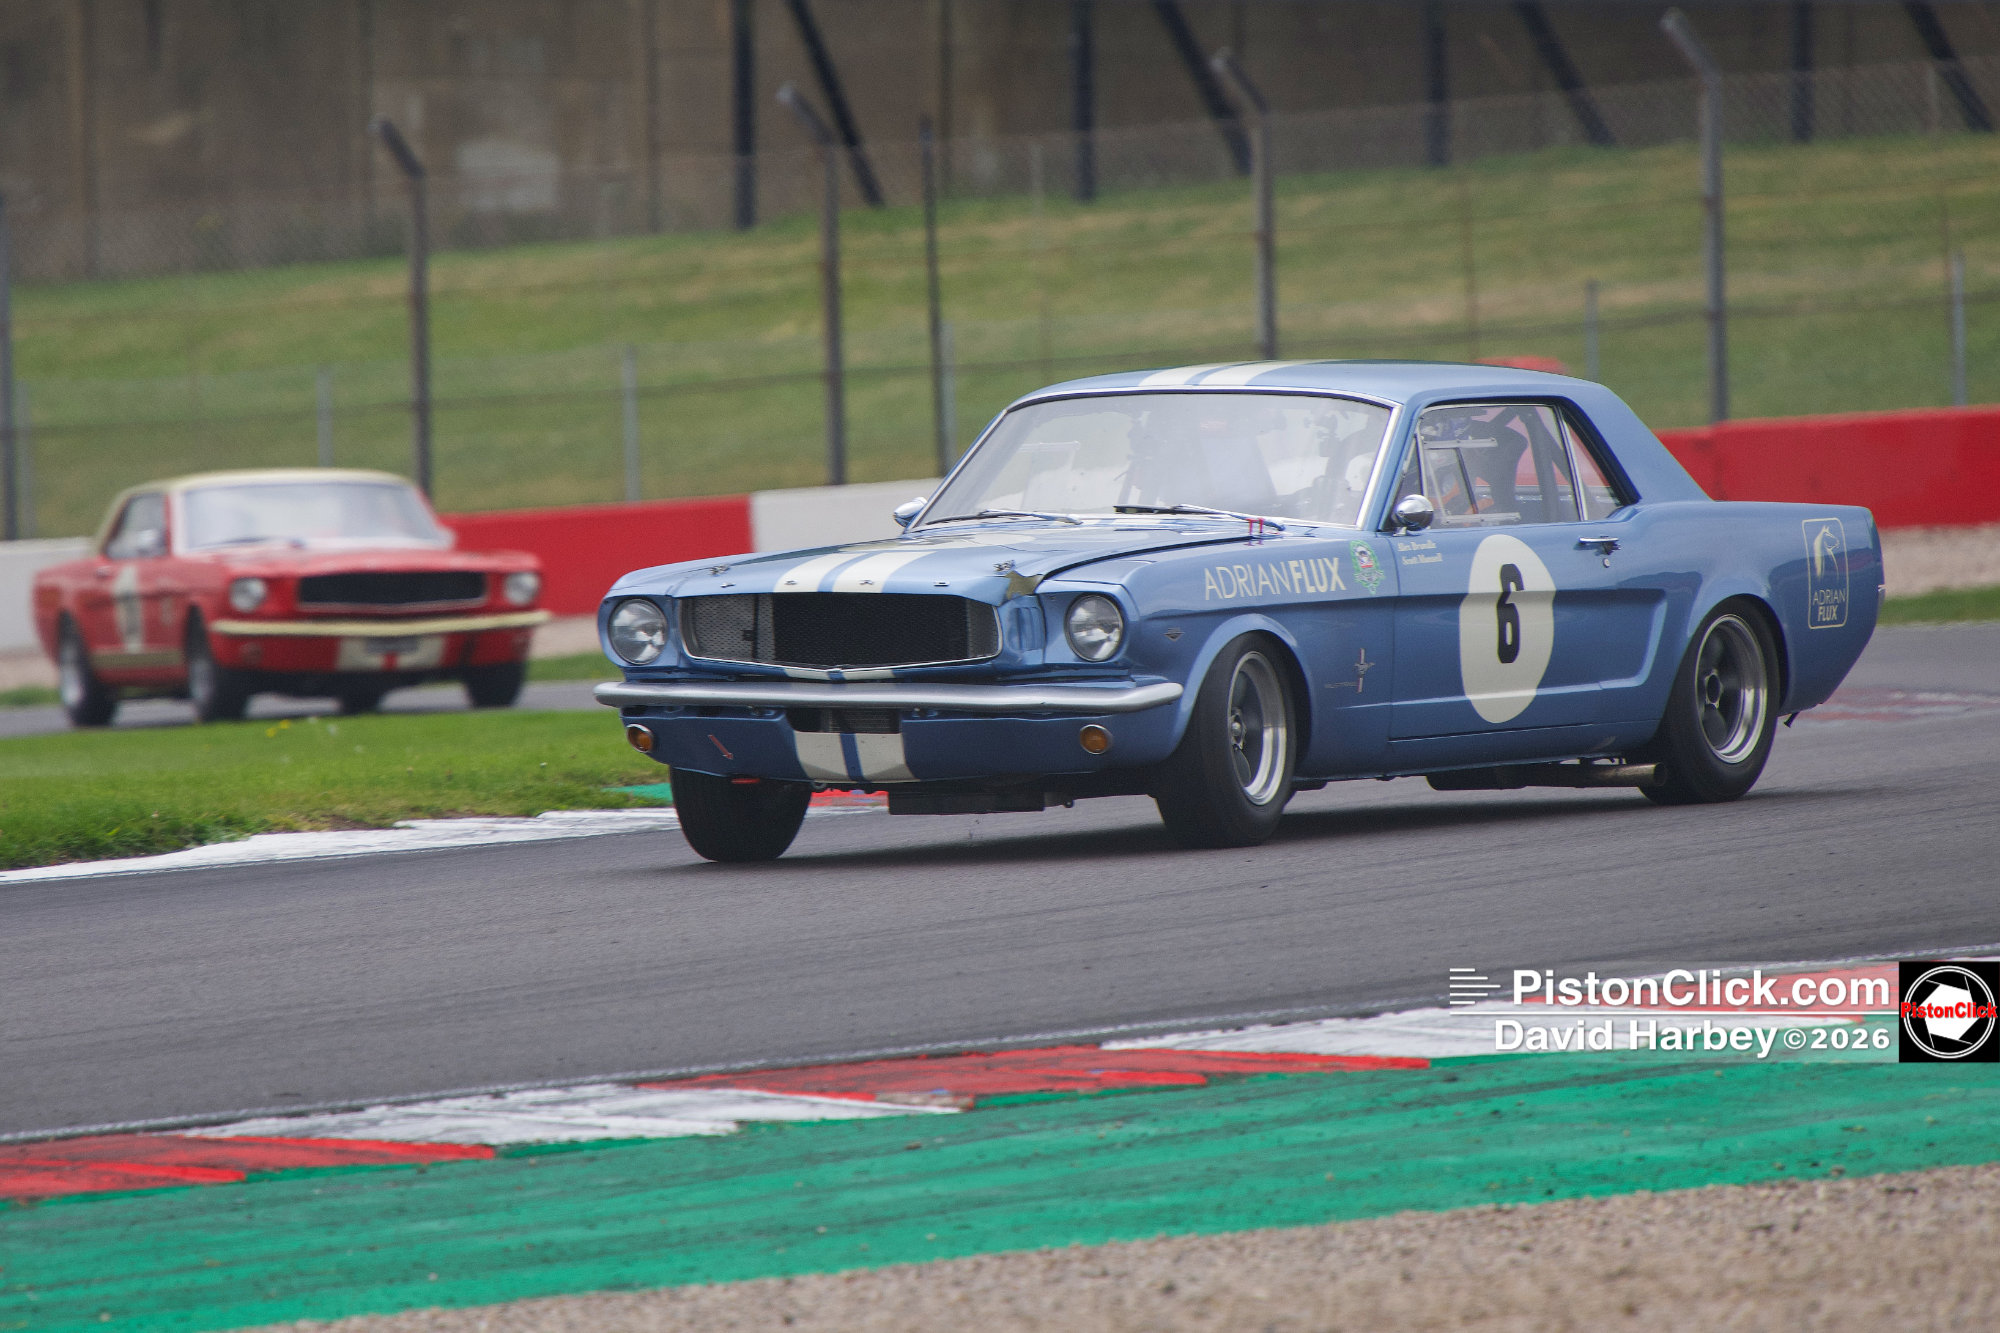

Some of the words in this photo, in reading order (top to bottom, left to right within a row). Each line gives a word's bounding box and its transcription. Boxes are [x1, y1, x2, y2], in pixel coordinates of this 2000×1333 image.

[1813, 588, 1846, 606] ADRIAN
[1497, 563, 1525, 664] 6
[1818, 604, 1838, 622] FLUX
